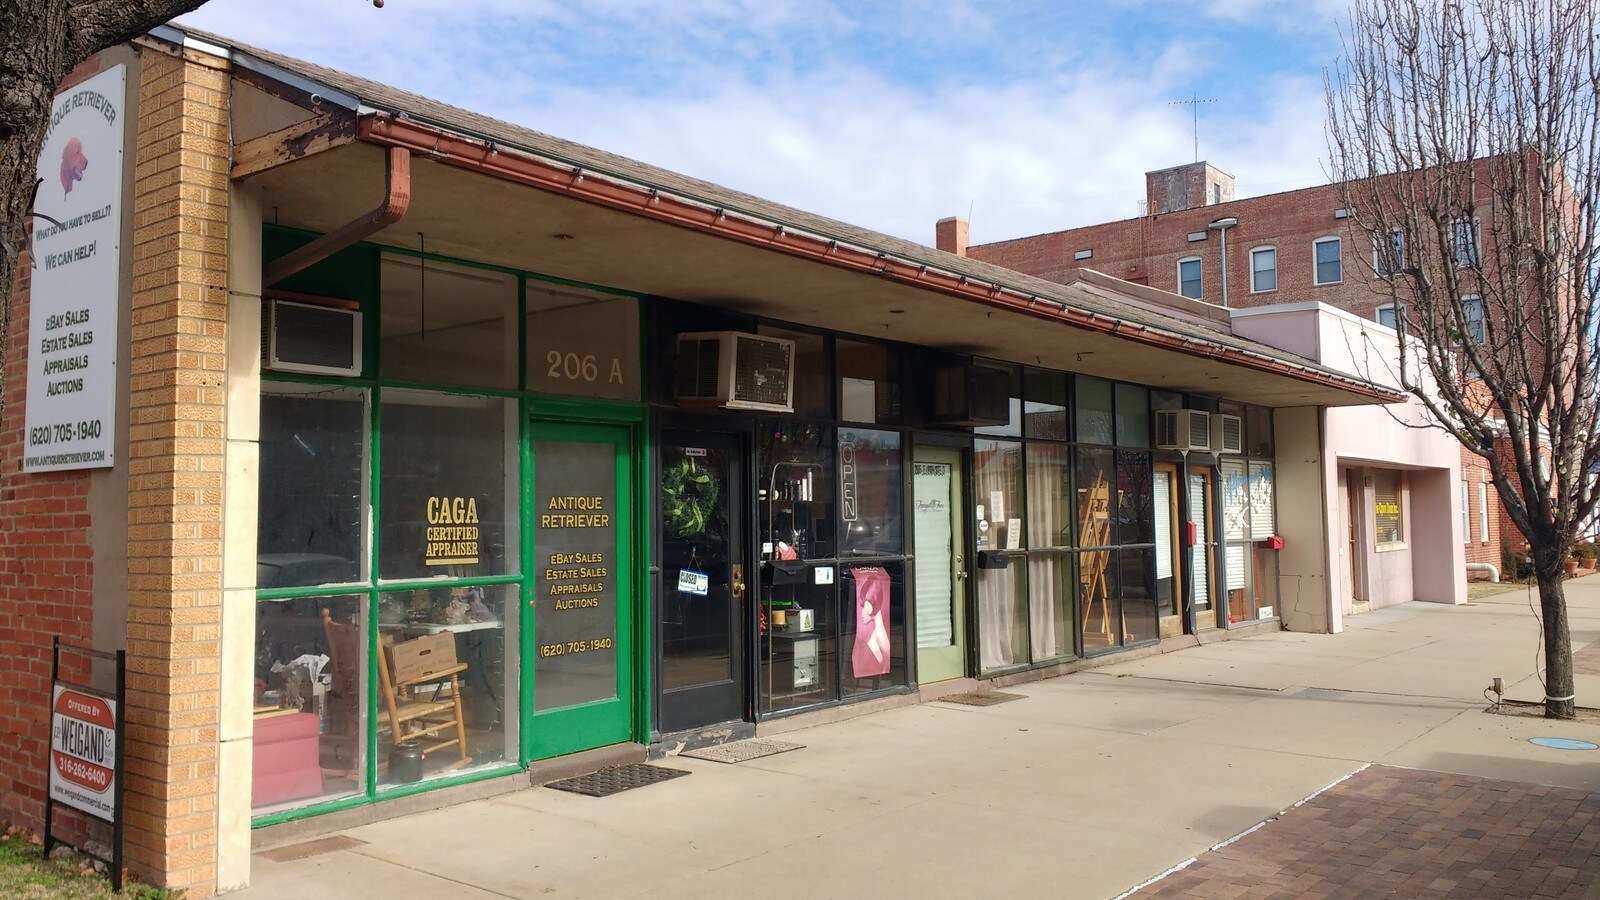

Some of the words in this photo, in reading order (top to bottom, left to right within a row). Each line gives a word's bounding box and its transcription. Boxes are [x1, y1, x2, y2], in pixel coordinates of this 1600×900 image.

[72, 91, 116, 127] RETRIEVER
[36, 227, 51, 242] WHAT
[51, 225, 58, 236] DO
[69, 215, 83, 230] HAVE
[83, 213, 91, 224] TO
[91, 204, 112, 222] SELL??
[44, 253, 57, 271] WE
[57, 249, 73, 267] CAN
[73, 239, 97, 262] HELP!
[65, 308, 90, 327] SALES
[41, 336, 68, 354] ESTATE
[68, 331, 93, 348] SALES
[43, 355, 89, 376] APPRAISALS
[546, 350, 598, 382] 206
[608, 358, 624, 385] A
[46, 378, 84, 397] AUCTIONS
[29, 424, 52, 447] (620)
[842, 446, 855, 516] OPEN
[427, 496, 479, 524] CAGA
[548, 496, 603, 511] ANTIQUE
[541, 514, 609, 528] RETRIEVER
[426, 526, 479, 541] CERTIFIED
[425, 541, 479, 557] APPRAISER
[575, 552, 603, 563] SALES
[545, 569, 579, 580] ESTATE
[579, 567, 607, 578] SALES
[680, 571, 698, 585] CLOSED
[549, 583, 604, 595] APPRAISALS
[555, 598, 599, 610] AUCTIONS
[540, 643, 566, 658] (620)
[67, 699, 92, 715] OFFERED
[91, 705, 101, 717] BY
[61, 716, 105, 763] WEIGAND
[59, 757, 106, 786] 316-262-6400
